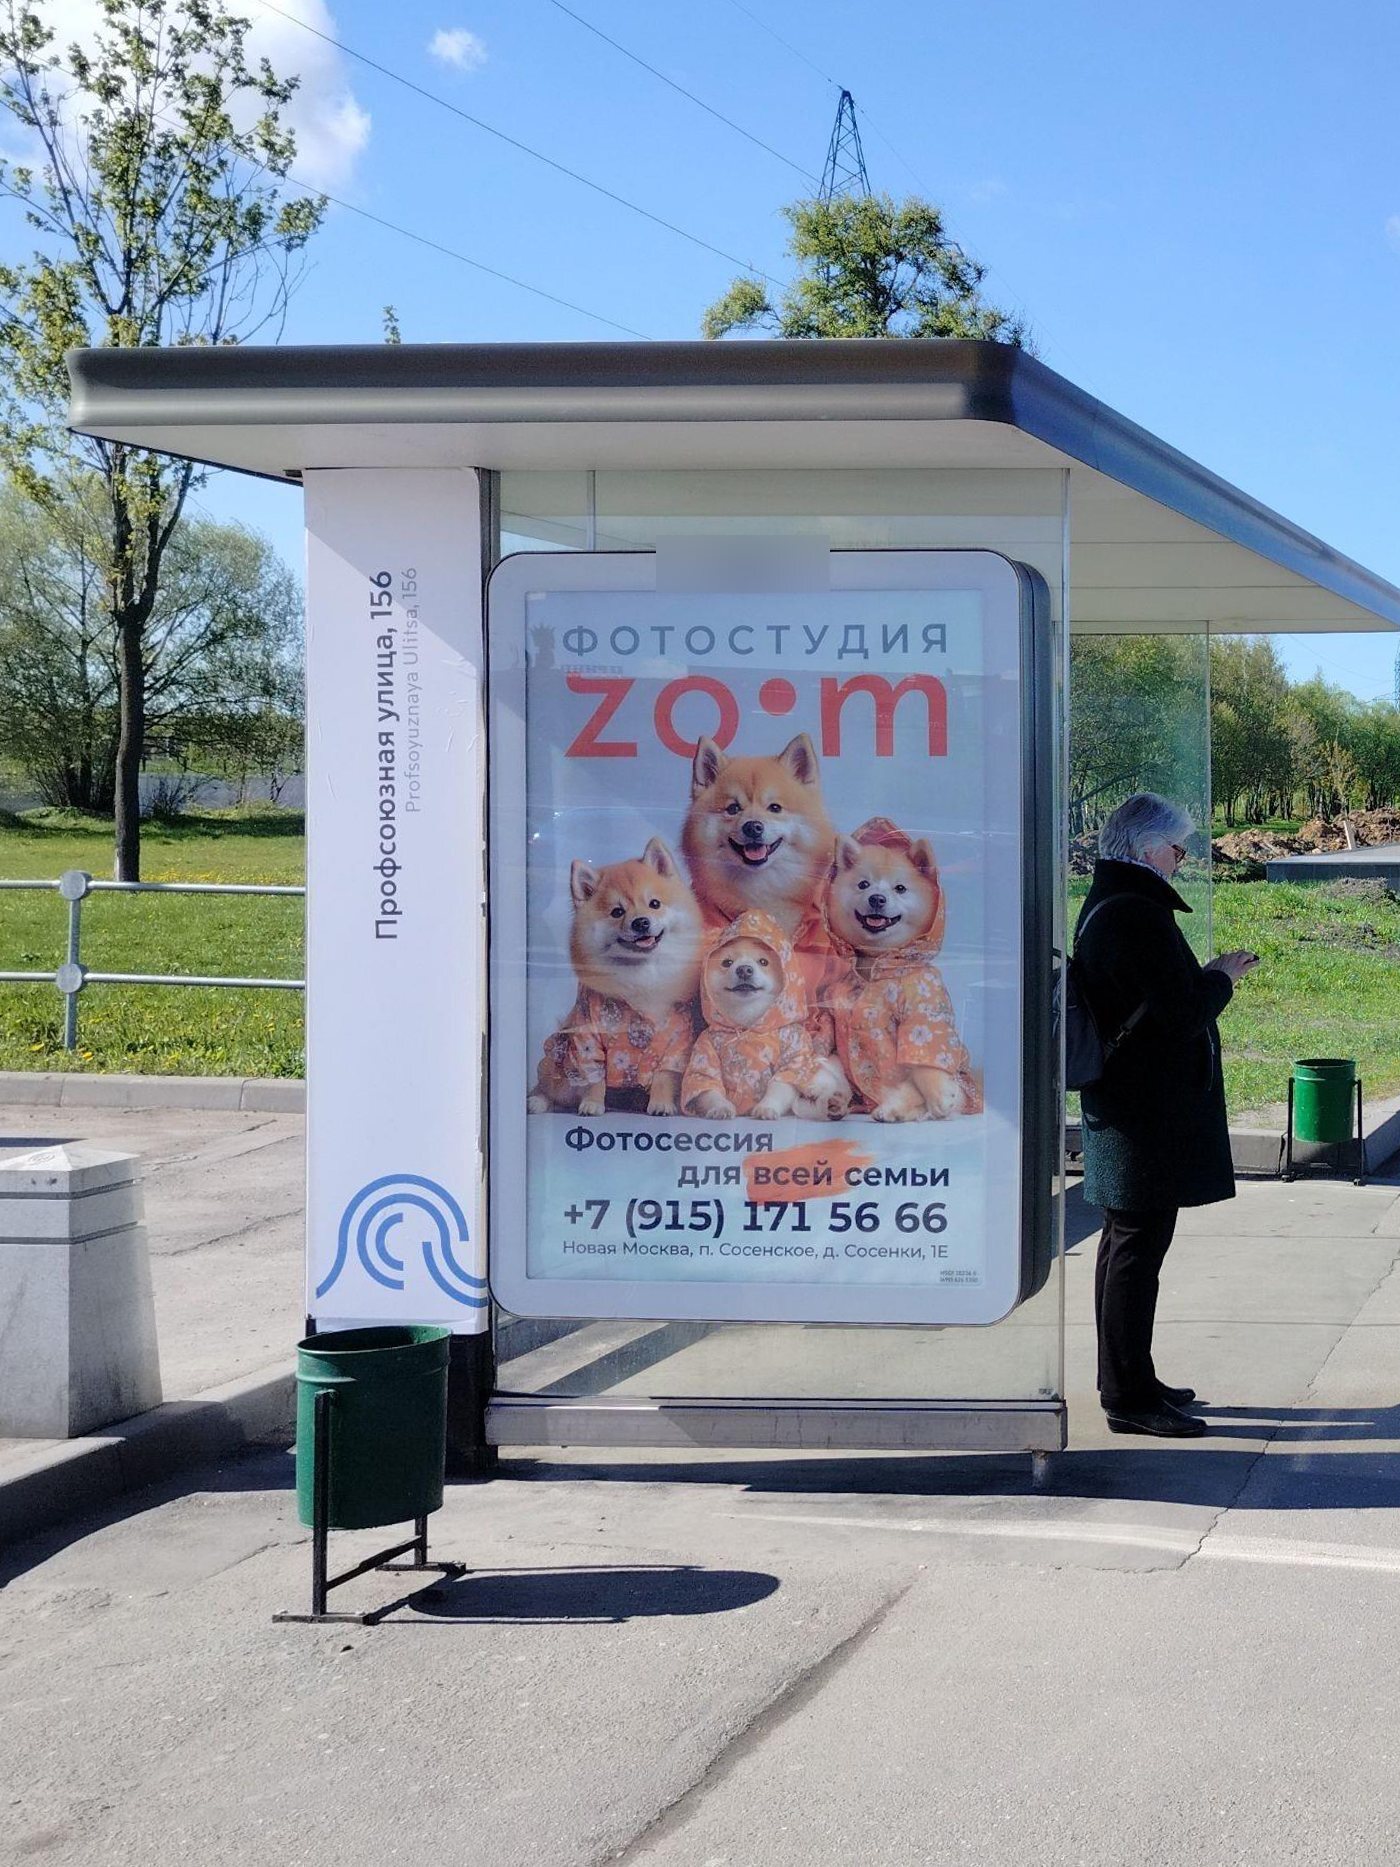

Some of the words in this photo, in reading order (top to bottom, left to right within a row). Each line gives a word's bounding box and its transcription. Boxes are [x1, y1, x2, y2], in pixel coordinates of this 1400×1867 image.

[369, 570, 394, 620] 156
[401, 567, 418, 600] 156
[402, 603, 420, 666] Ulitsa,
[562, 622, 948, 660] ФОТОСТУДИЯ
[375, 622, 400, 722] улица,
[405, 671, 424, 813] Profsoyuznaya
[372, 731, 403, 940] Профсоюзная
[564, 1126, 774, 1153] Фотосессия
[676, 1163, 741, 1189] для
[753, 1160, 833, 1187] всей
[844, 1166, 950, 1188] семьи
[563, 1199, 611, 1230] +7
[625, 1198, 726, 1239] (915)
[742, 1200, 812, 1233] 171
[828, 1201, 880, 1233] 56
[895, 1201, 949, 1234] 66
[562, 1240, 617, 1256] Новая
[622, 1241, 694, 1259] Москва,
[699, 1245, 715, 1258] п.
[719, 1242, 819, 1260] Сосенское,
[822, 1245, 840, 1261] д.
[844, 1243, 927, 1261] Сосенки,
